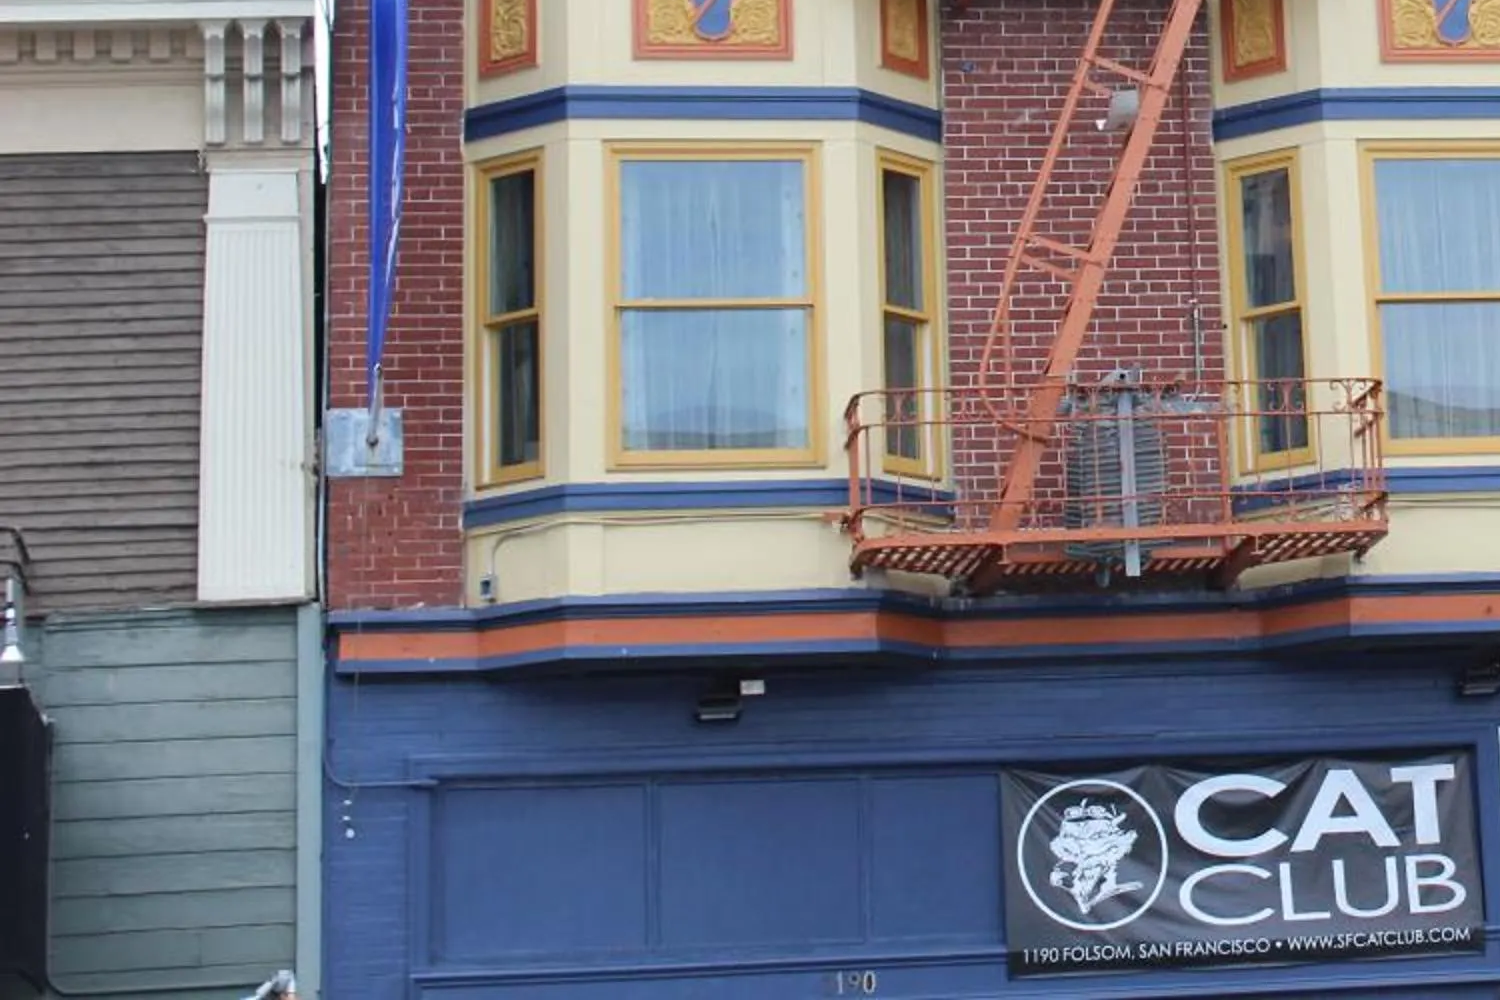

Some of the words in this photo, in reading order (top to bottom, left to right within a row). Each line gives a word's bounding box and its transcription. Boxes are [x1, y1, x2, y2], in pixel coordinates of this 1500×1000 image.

[1174, 763, 1455, 857] CAT
[1178, 853, 1467, 926] CLUB
[1023, 947, 1060, 964] 1190
[1139, 942, 1171, 959] SAN
[1175, 937, 1270, 957] FRANCISCO
[1286, 926, 1471, 951] WWW.SFCATCLUB.COM
